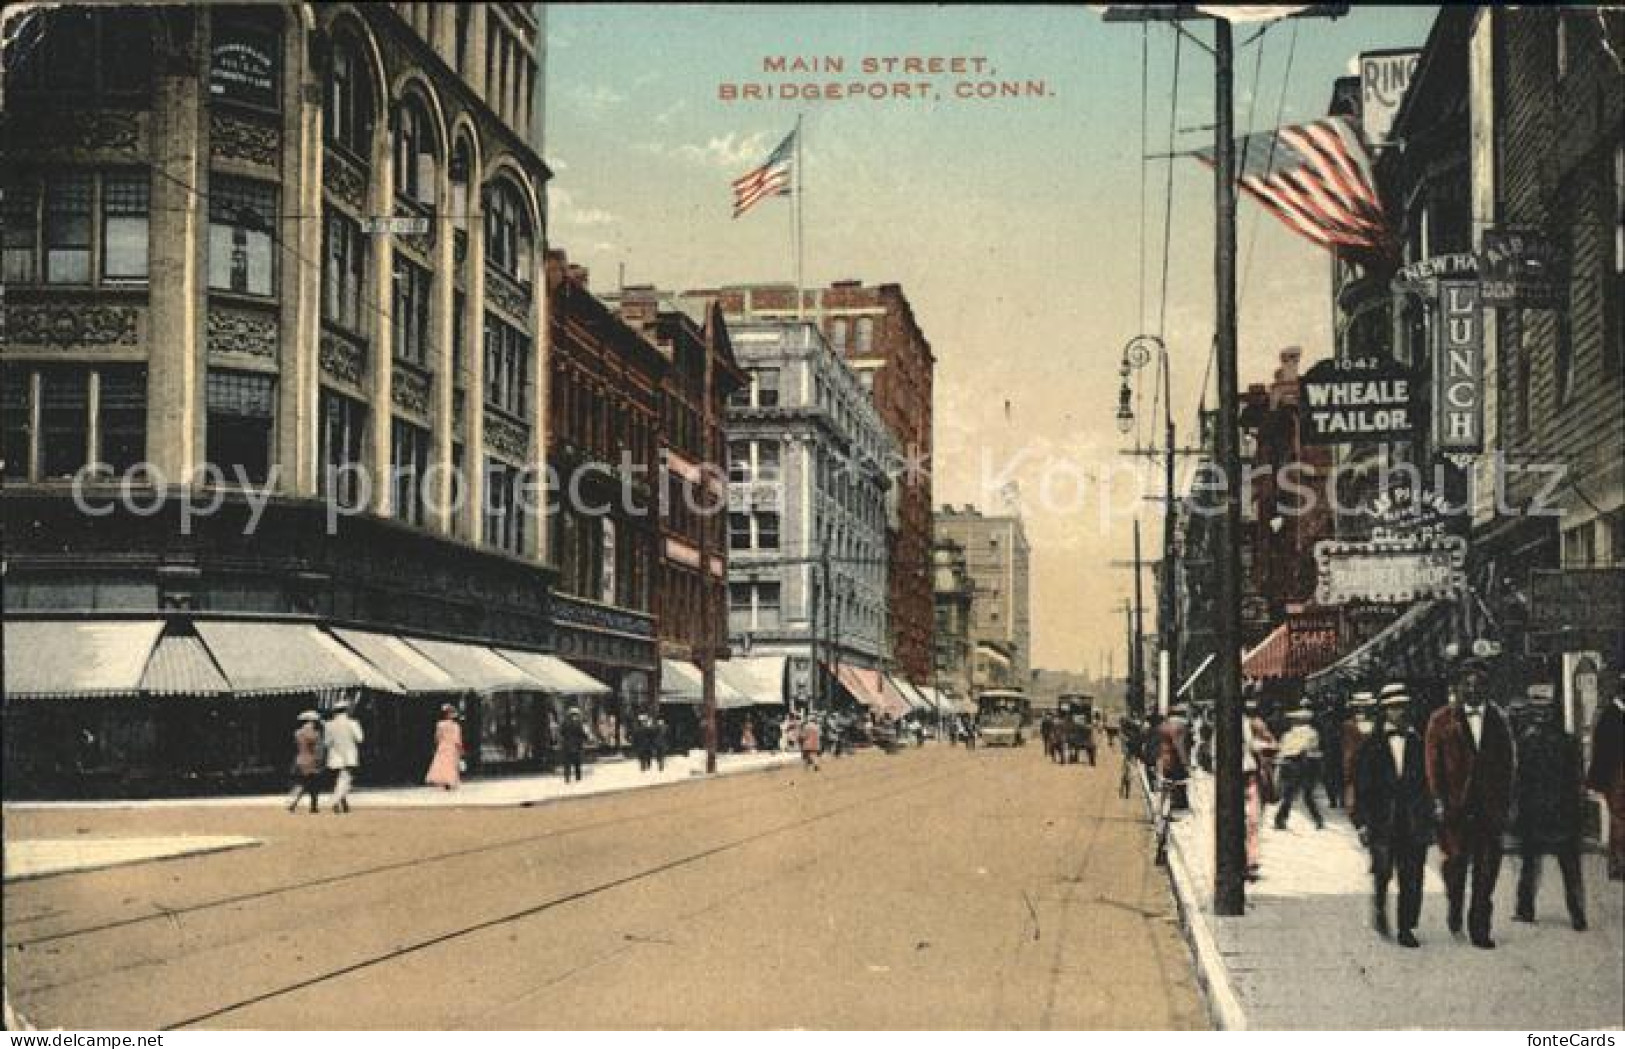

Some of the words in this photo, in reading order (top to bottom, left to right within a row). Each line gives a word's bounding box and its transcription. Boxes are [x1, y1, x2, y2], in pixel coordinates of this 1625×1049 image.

[1451, 253, 1480, 273] HA
[1448, 288, 1475, 439] LUNCH
[1306, 379, 1410, 407] WHEALE
[1311, 408, 1413, 433] TAILOR.
